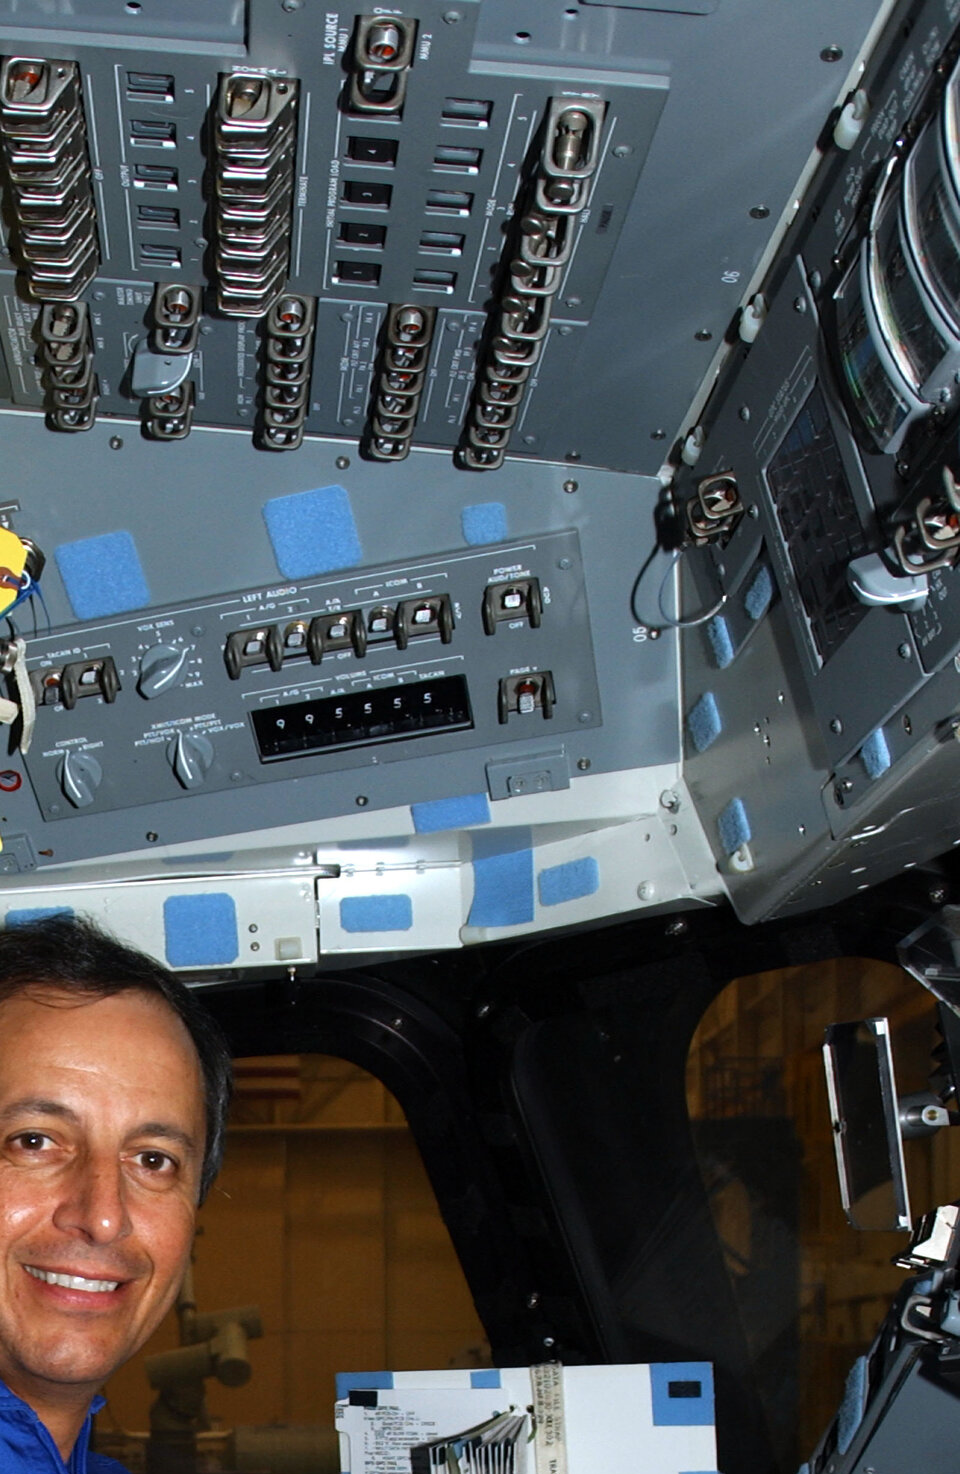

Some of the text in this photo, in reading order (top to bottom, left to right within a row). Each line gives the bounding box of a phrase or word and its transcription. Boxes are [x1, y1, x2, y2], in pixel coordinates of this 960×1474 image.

[323, 13, 339, 66] IPL SOURCE
[419, 33, 433, 61] MMU 2
[330, 160, 340, 182] LOAD
[120, 165, 131, 188] OUTPUT
[297, 175, 309, 208] TERMINATE
[493, 564, 523, 575] POWER
[385, 578, 409, 587] ICOM
[242, 586, 298, 603] LEFT AUDIO
[137, 619, 175, 632] VOX SENS
[508, 621, 524, 630] OFF
[46, 649, 74, 659] TACAN
[335, 670, 368, 681] VOLUME
[418, 670, 445, 678] TACAN
[509, 666, 531, 675] PAGE
[373, 672, 395, 681] ICOM
[184, 680, 204, 688] MAX
[393, 697, 402, 708] 5
[423, 693, 432, 703] 5
[335, 708, 344, 718] 5
[364, 703, 372, 713] 5
[192, 712, 217, 723] MODE
[305, 714, 314, 725] 9
[207, 721, 246, 734] VOX/VOX
[276, 719, 286, 729] 9
[55, 737, 88, 747] CONTROL
[82, 741, 104, 749] RIGHT
[42, 749, 66, 758] NORM
